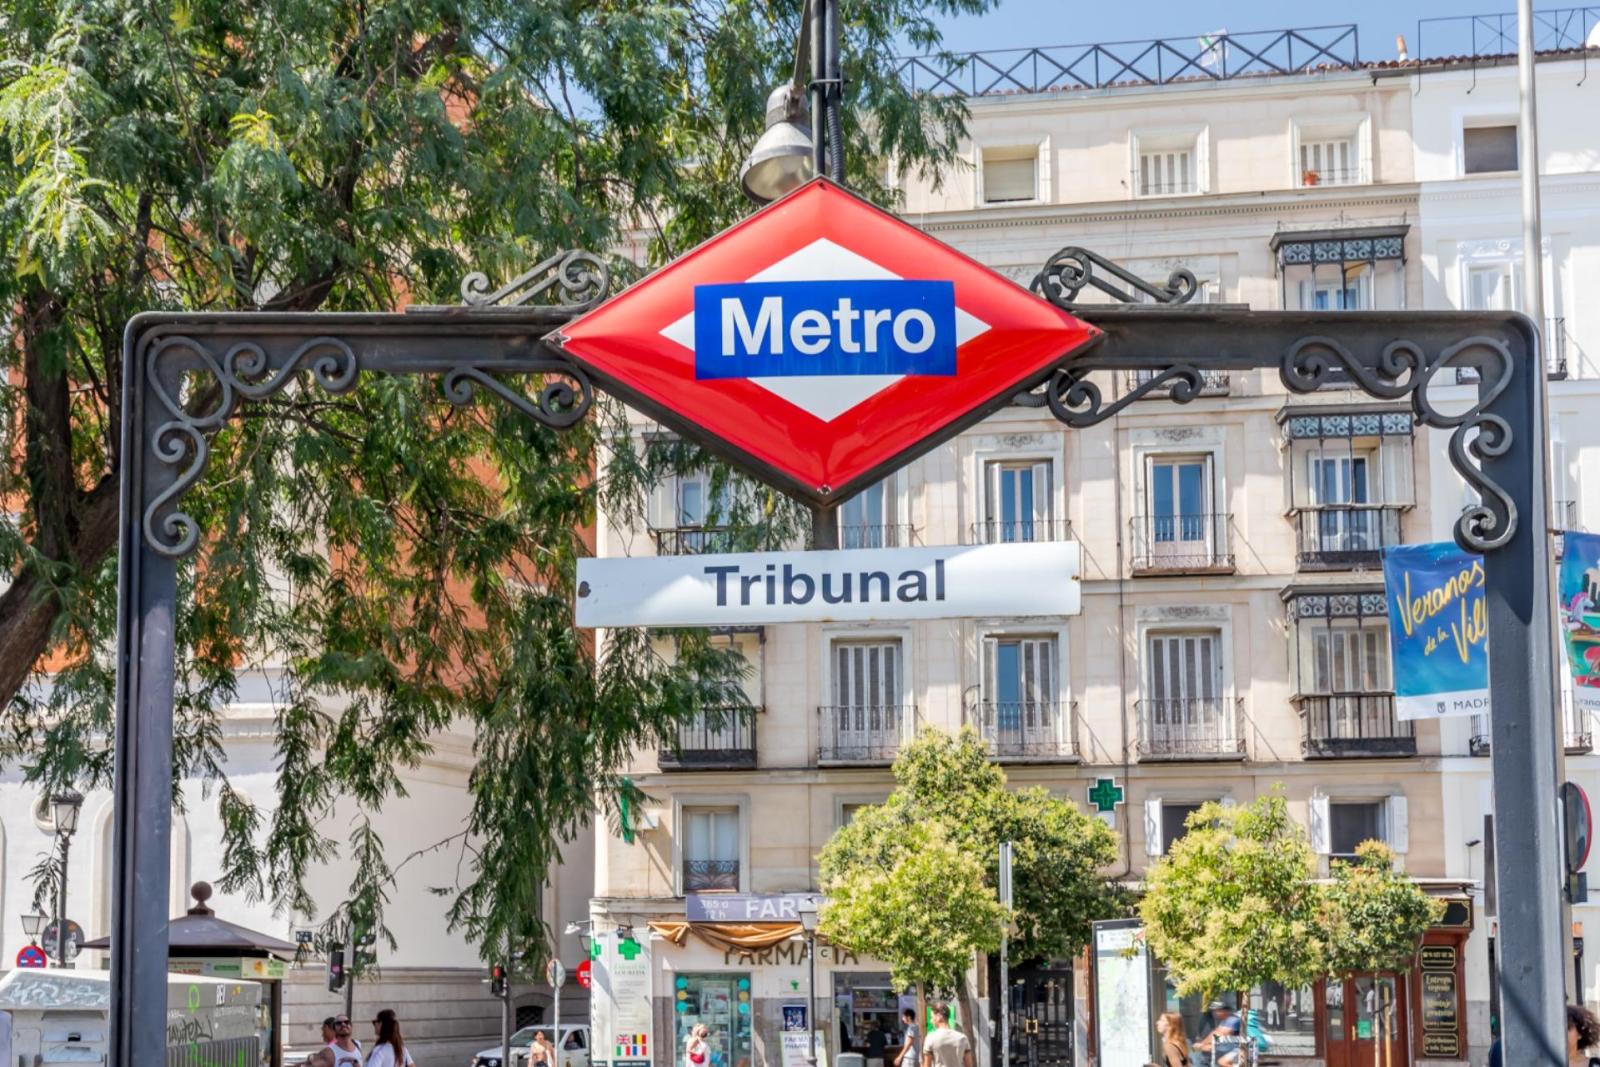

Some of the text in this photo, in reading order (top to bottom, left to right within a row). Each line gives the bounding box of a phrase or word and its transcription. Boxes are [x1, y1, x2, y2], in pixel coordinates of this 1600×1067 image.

[721, 296, 936, 357] Metro
[704, 559, 946, 606] Tribunal
[1396, 560, 1485, 636] Veranos
[1451, 596, 1488, 664] Vill
[1453, 698, 1489, 710] MADR
[745, 898, 798, 918] FAR
